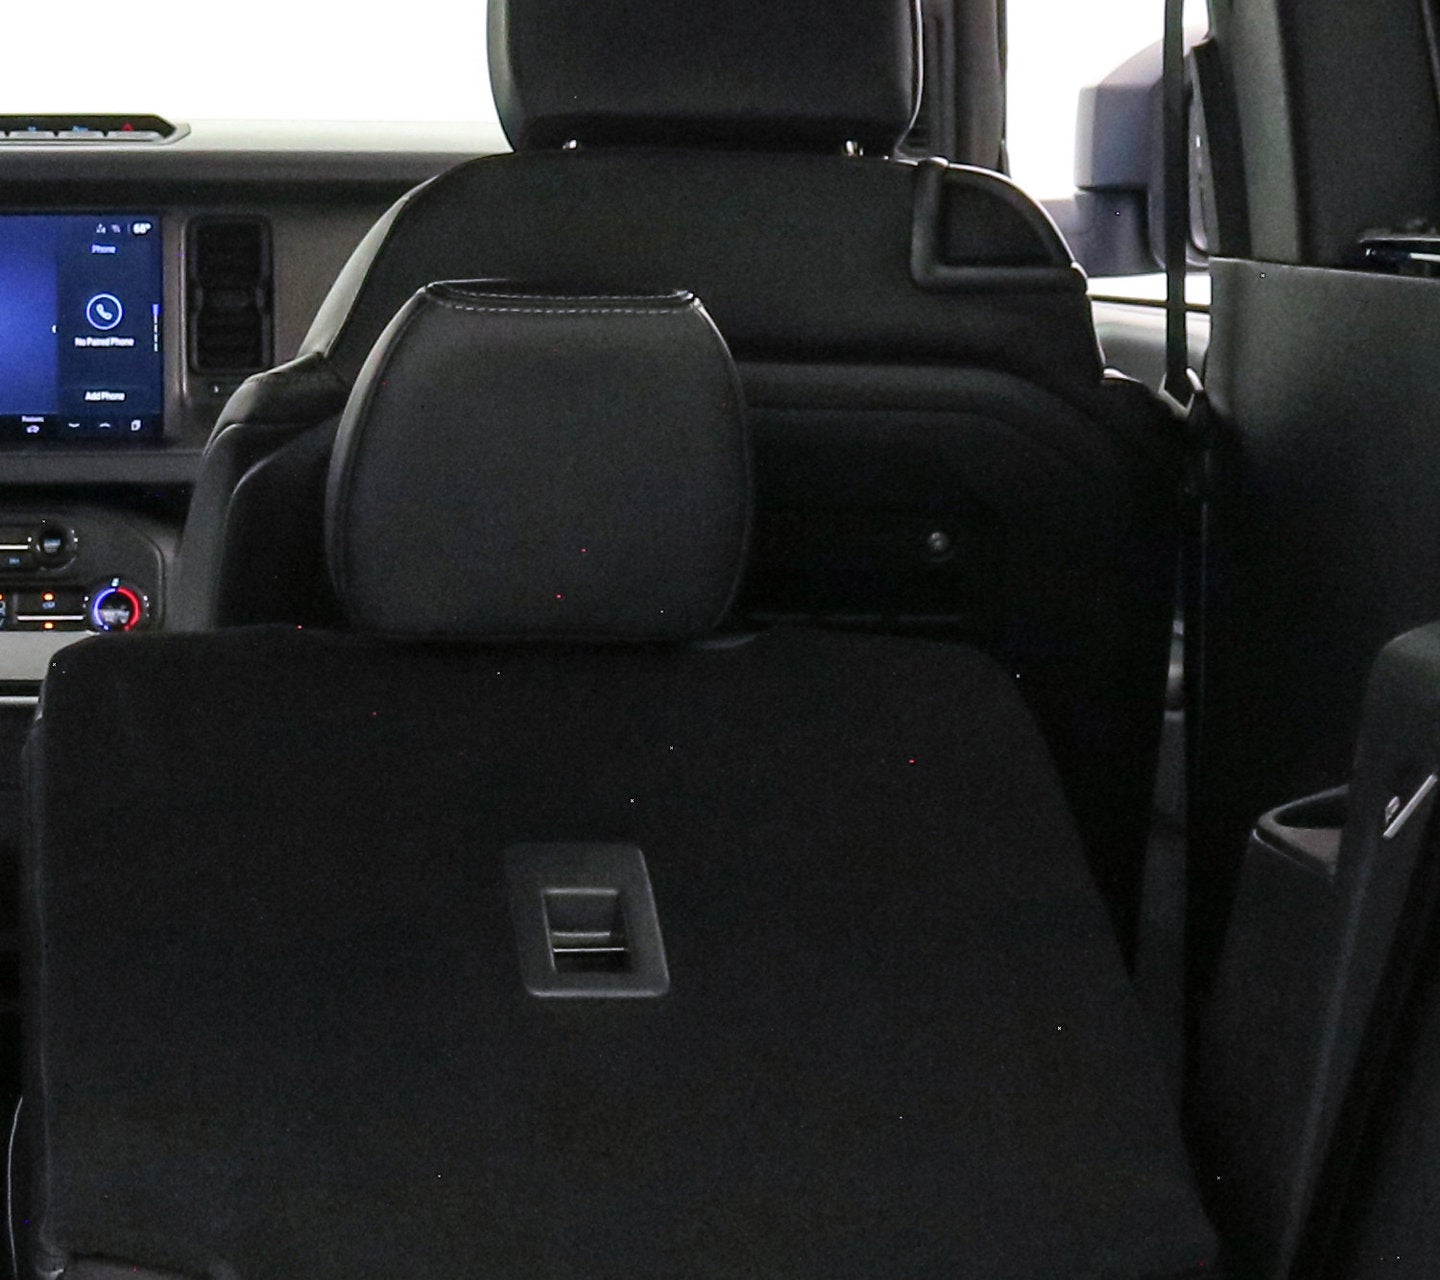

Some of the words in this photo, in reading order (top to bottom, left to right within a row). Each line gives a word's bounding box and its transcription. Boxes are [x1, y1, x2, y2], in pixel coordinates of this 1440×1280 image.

[91, 244, 116, 254] Phone
[74, 337, 86, 347] No
[86, 337, 110, 347] Paired
[111, 337, 135, 347] Phone
[84, 391, 101, 401] Add
[101, 391, 126, 401] Phone
